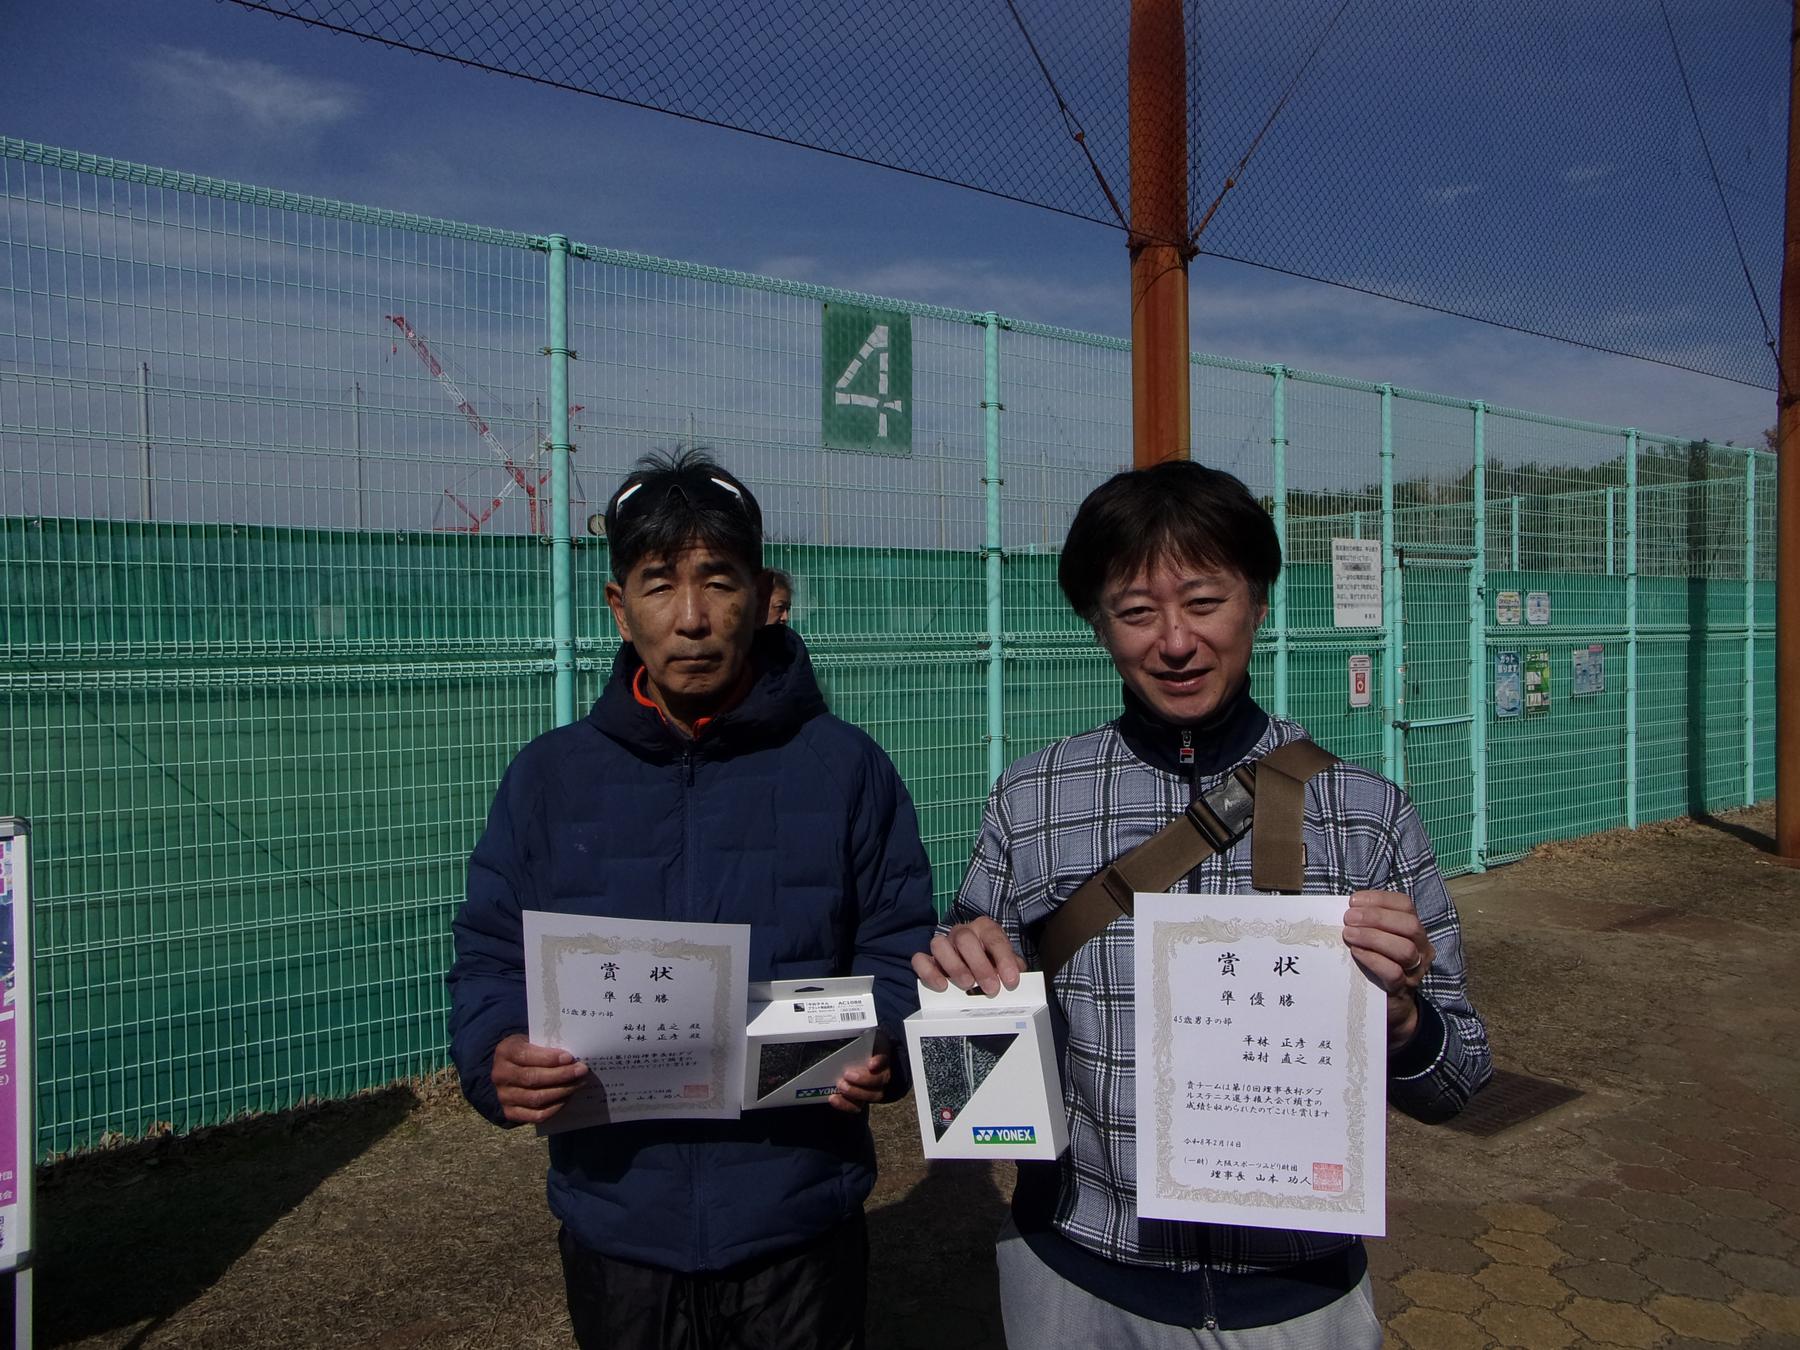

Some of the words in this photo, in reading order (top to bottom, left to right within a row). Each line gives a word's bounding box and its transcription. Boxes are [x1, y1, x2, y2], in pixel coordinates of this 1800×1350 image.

[835, 325, 902, 437] 4
[603, 991, 669, 1003] 準優勝
[1220, 990, 1296, 1007] 準優勝
[1173, 1015, 1233, 1026] 45歳男子の部
[997, 1129, 1033, 1141] YONEX
